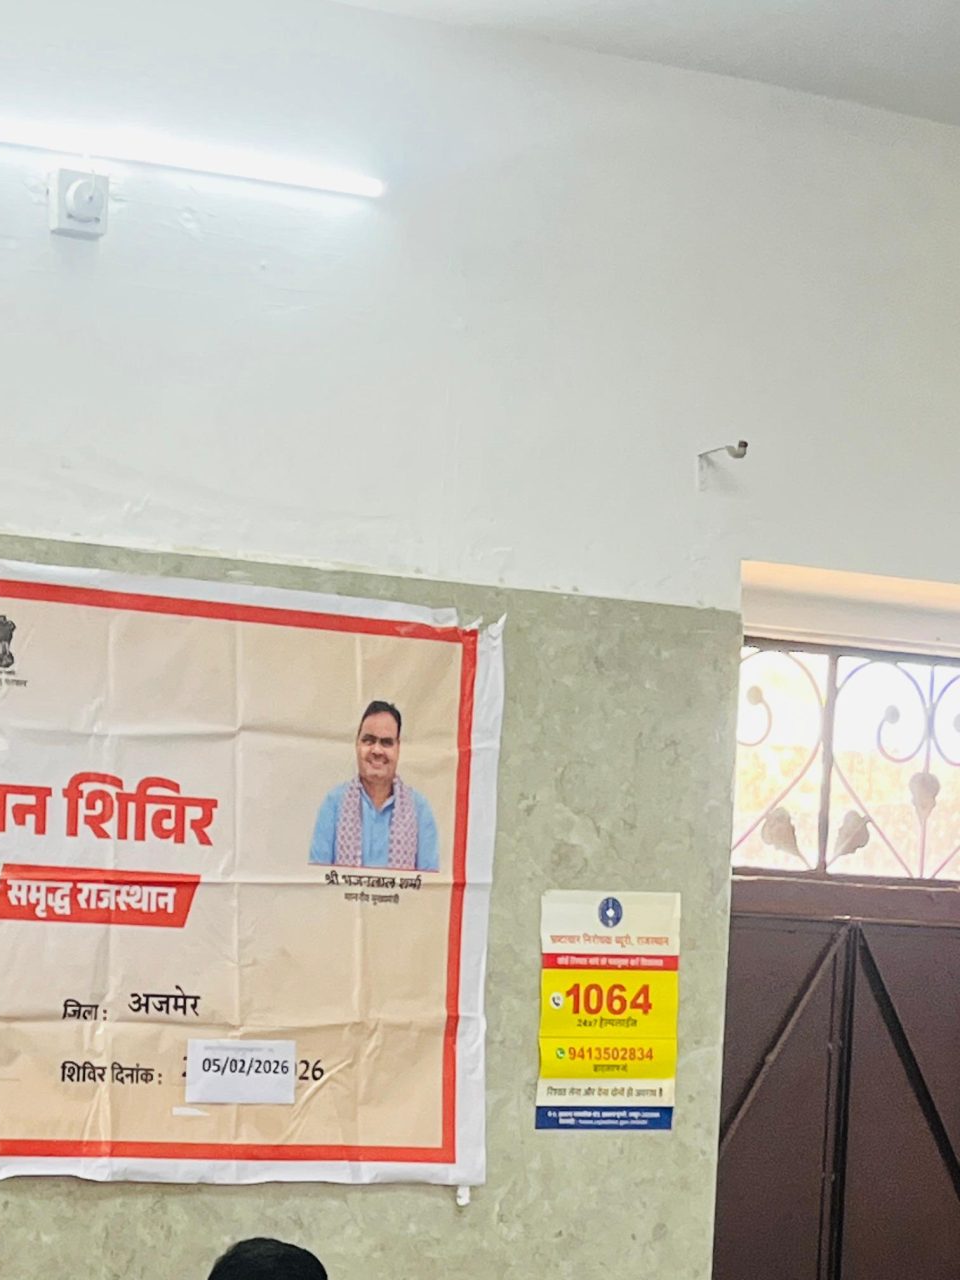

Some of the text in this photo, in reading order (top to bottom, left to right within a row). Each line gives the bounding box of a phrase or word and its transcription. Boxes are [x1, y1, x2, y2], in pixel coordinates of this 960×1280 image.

[62, 772, 218, 847] शिविर
[325, 870, 339, 886] श्री
[7, 878, 177, 917] समृद्ध राजस्थान
[128, 985, 201, 1017] अजमेर
[566, 983, 653, 1016] 1064
[61, 1060, 107, 1083] शिविर
[202, 1056, 289, 1076] 05/02/2026
[568, 1047, 654, 1060] 9413502834
